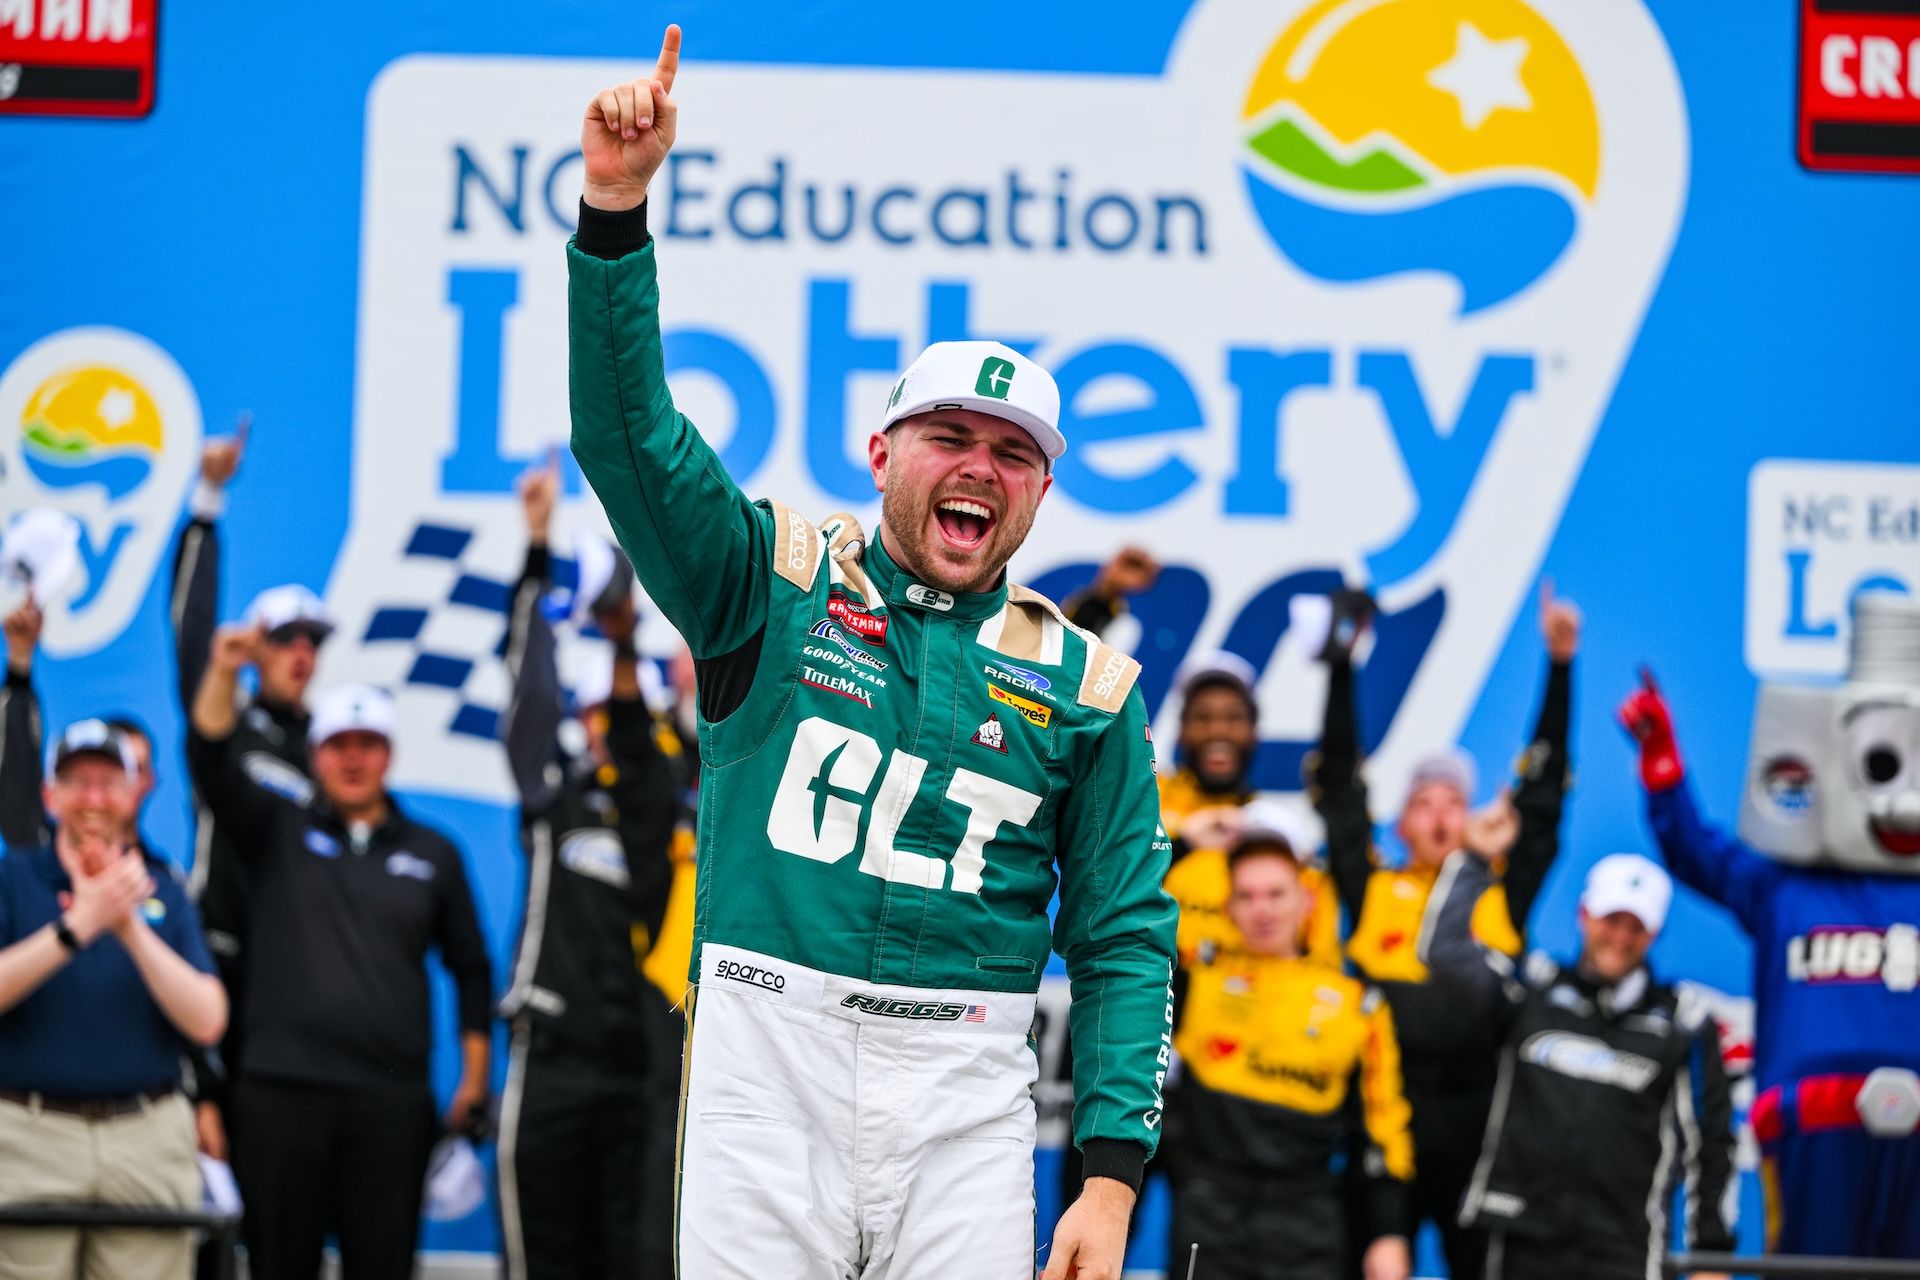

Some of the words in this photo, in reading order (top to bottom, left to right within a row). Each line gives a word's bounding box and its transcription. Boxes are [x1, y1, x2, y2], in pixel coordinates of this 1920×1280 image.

[664, 150, 1209, 254] Education
[828, 602, 883, 632] RAFTSMAN
[803, 645, 887, 688] GOODYEAR
[984, 665, 1057, 701] RACING
[1094, 651, 1127, 699] sparco
[766, 716, 1043, 896] CLT
[715, 960, 785, 992] sparco
[841, 992, 967, 1021] RIGGS
